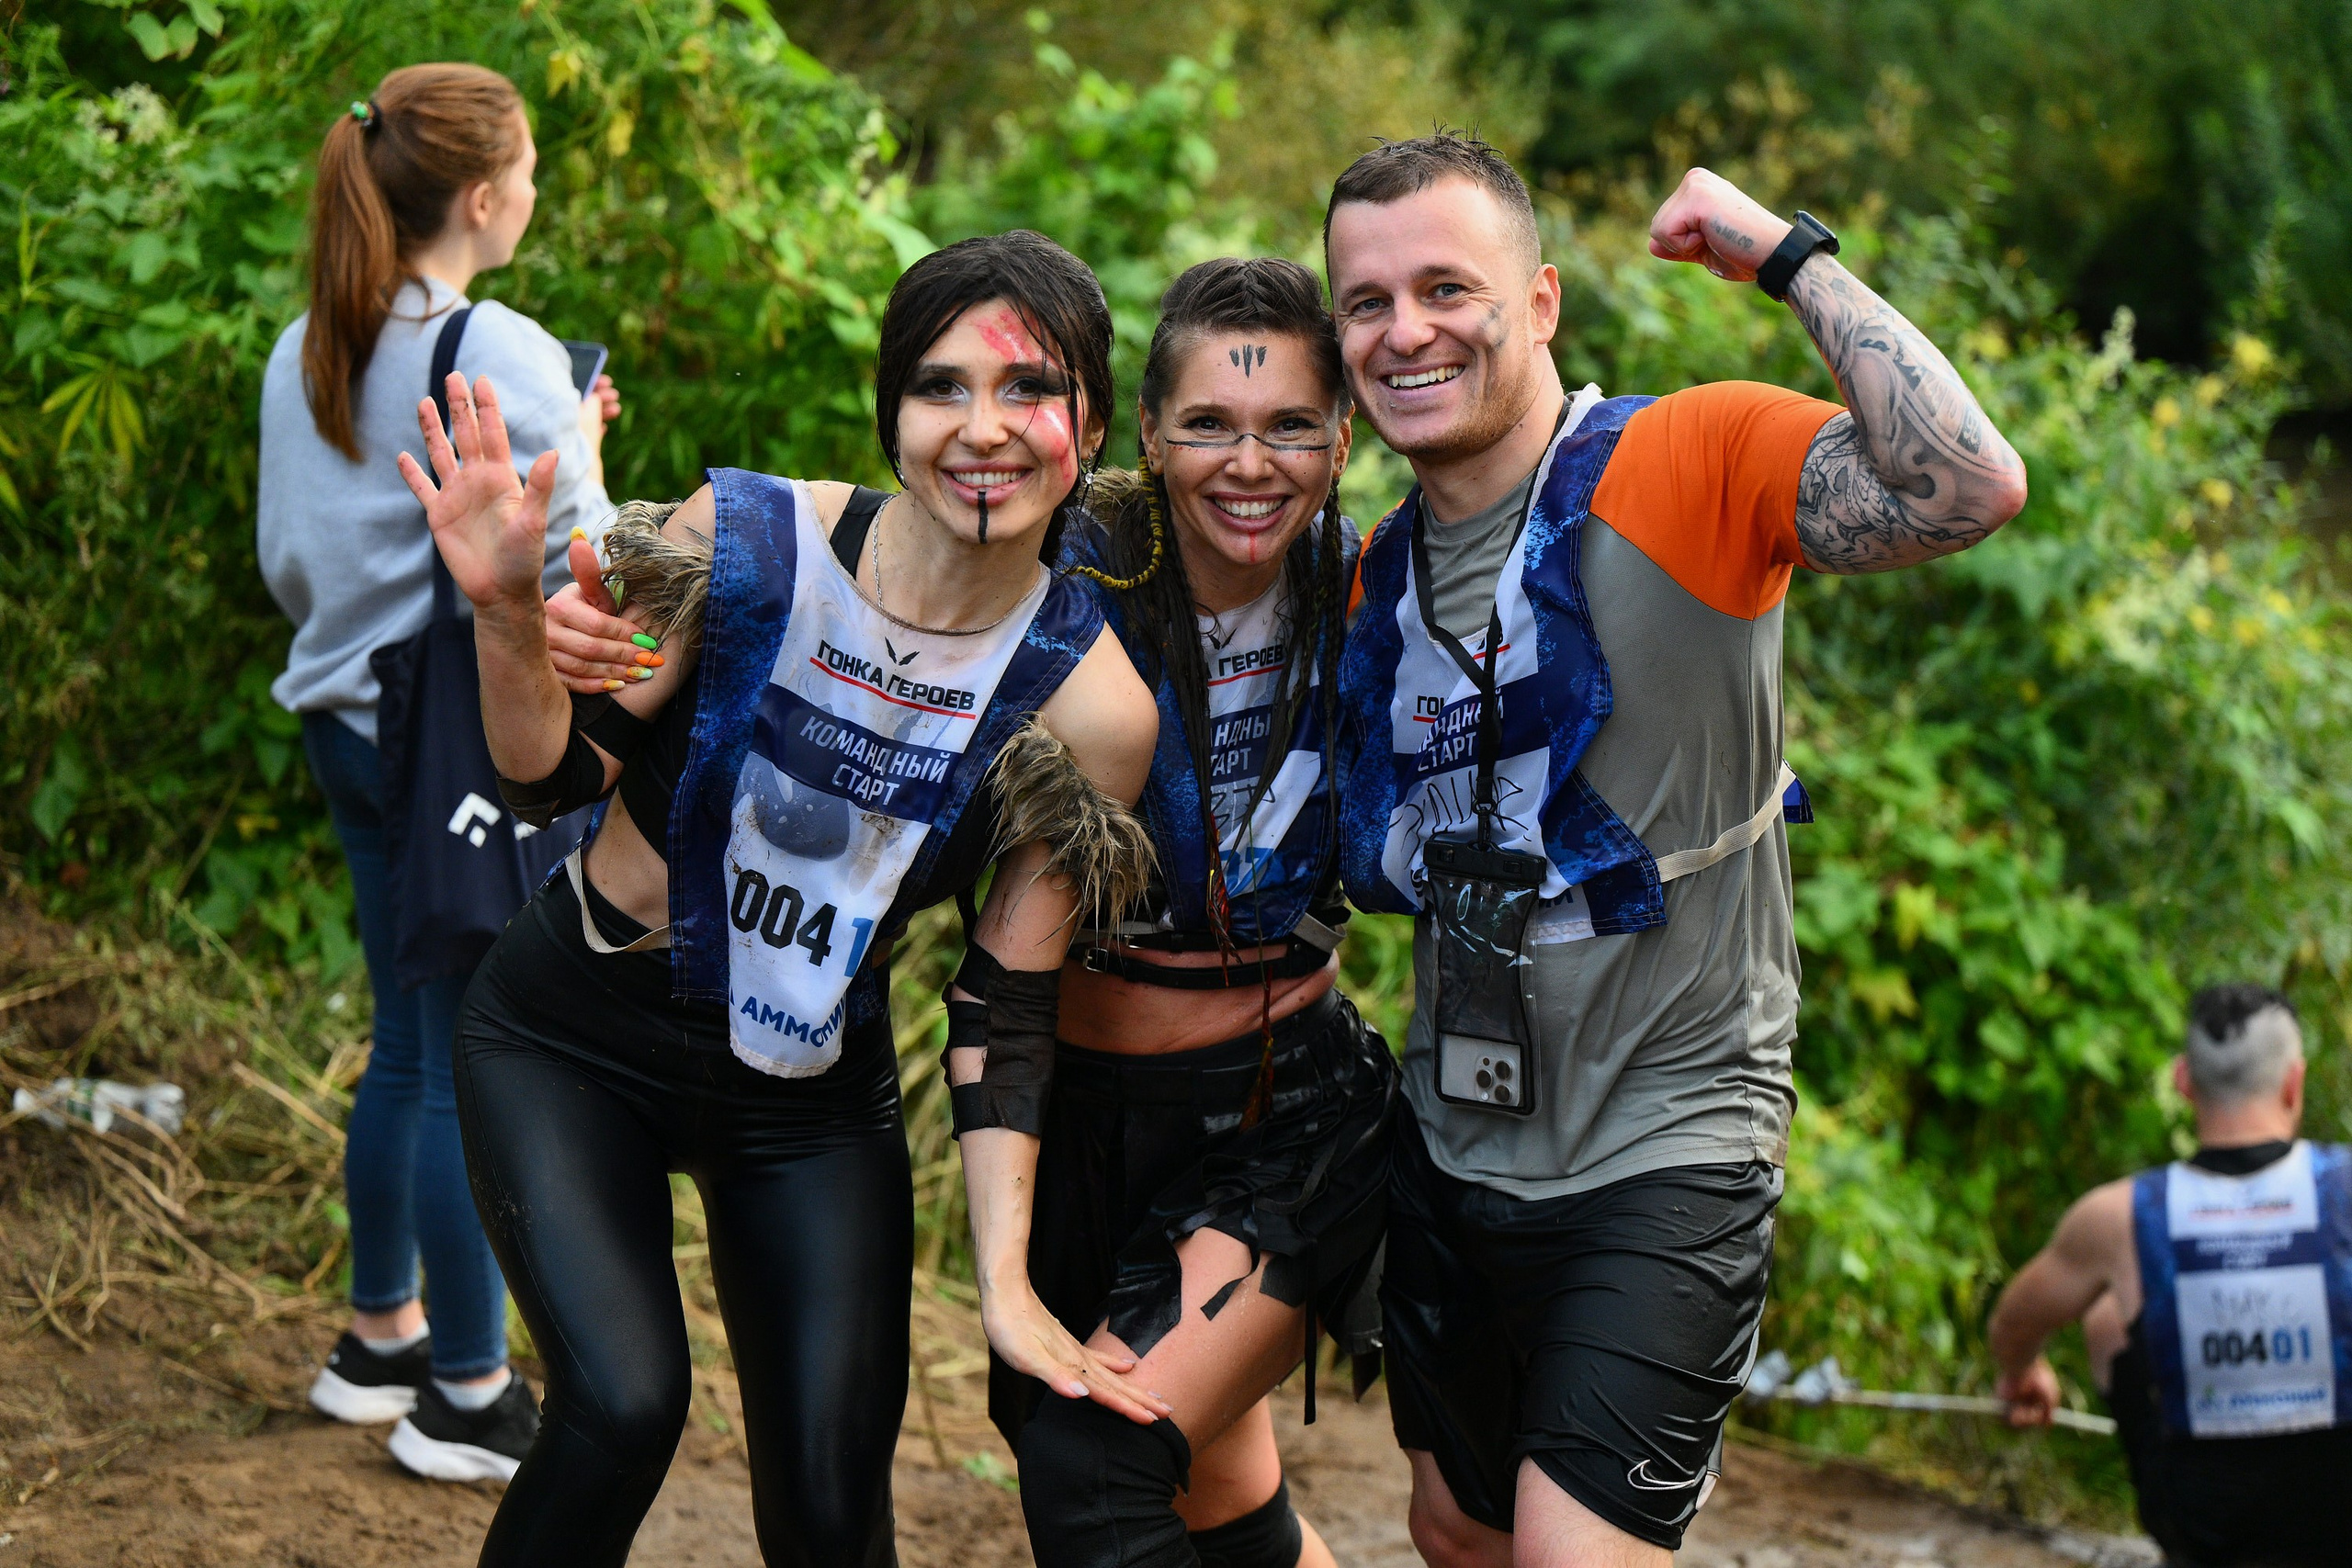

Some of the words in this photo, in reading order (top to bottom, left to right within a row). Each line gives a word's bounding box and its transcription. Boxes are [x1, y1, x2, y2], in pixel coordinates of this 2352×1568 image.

[817, 639, 883, 684] ГОНКА
[885, 673, 976, 711] ГЕРОЕВ
[799, 716, 950, 784] КОМАНДНЫЙ
[832, 762, 900, 807] СТАРТ
[2203, 1325, 2312, 1367] 00401
